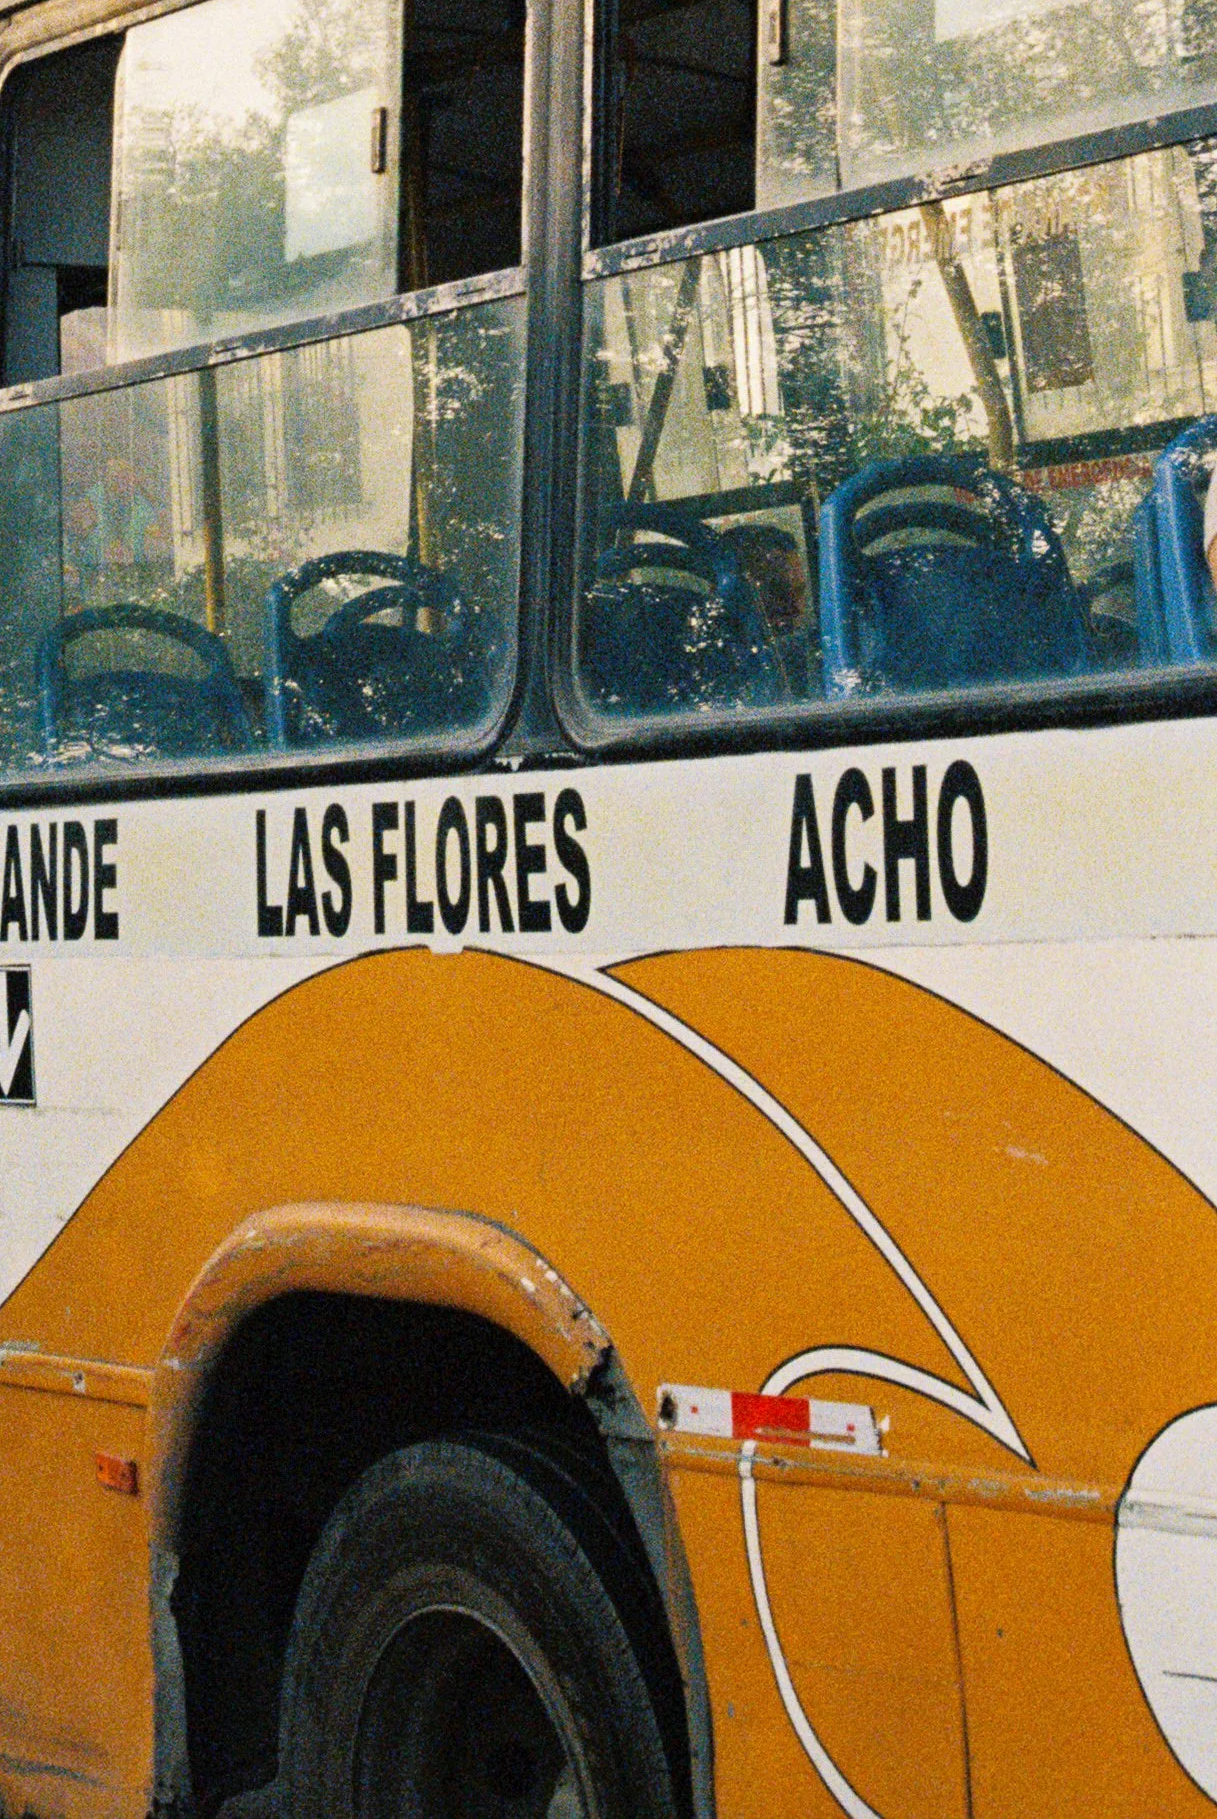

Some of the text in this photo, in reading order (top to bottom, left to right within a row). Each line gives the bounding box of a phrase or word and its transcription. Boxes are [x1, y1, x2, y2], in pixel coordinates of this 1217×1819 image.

[256, 788, 591, 937] LAS FLORES
[784, 760, 988, 925] ACHO
